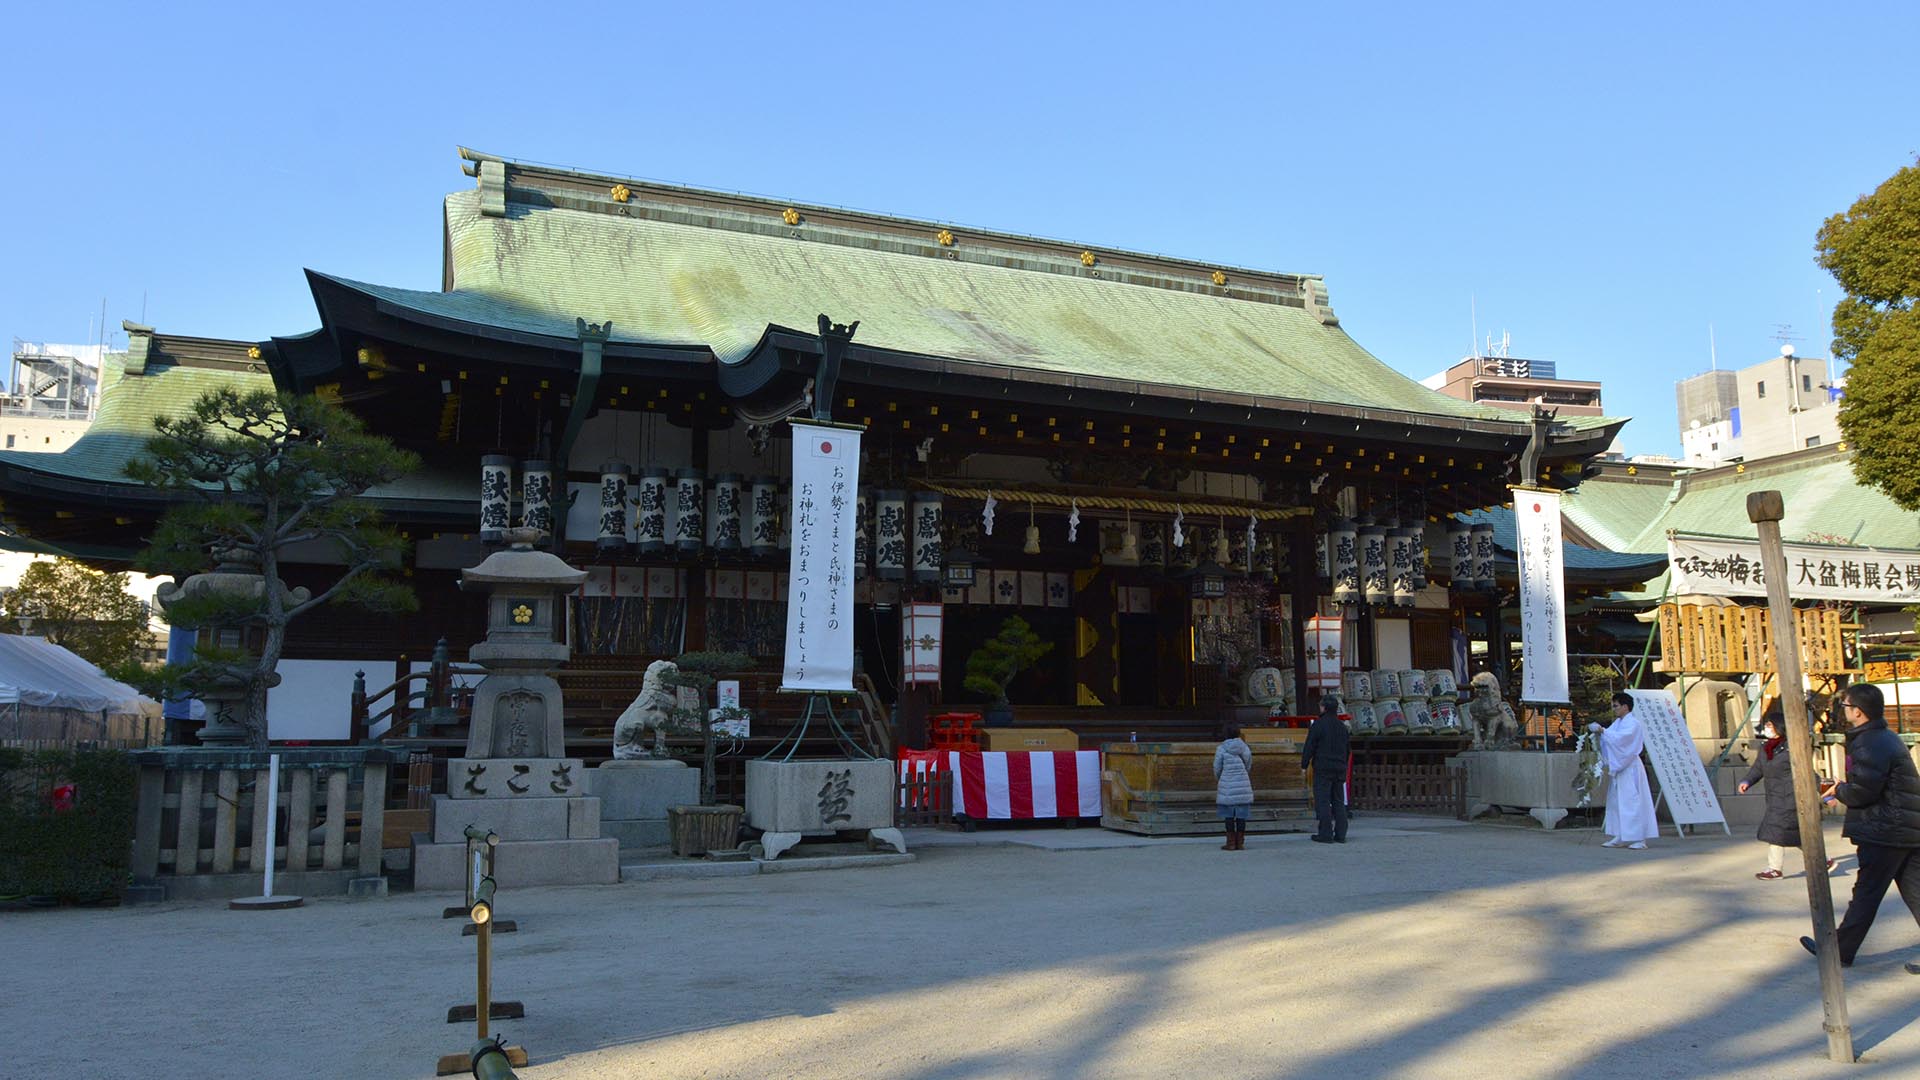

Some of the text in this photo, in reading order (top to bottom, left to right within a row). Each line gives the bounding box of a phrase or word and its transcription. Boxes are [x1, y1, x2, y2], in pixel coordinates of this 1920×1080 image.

[796, 483, 814, 681] お神札をおまつりしましょう
[827, 465, 845, 630] お伊勢さまと氏神さまの
[1795, 557, 1920, 592] 大盆梅展会場
